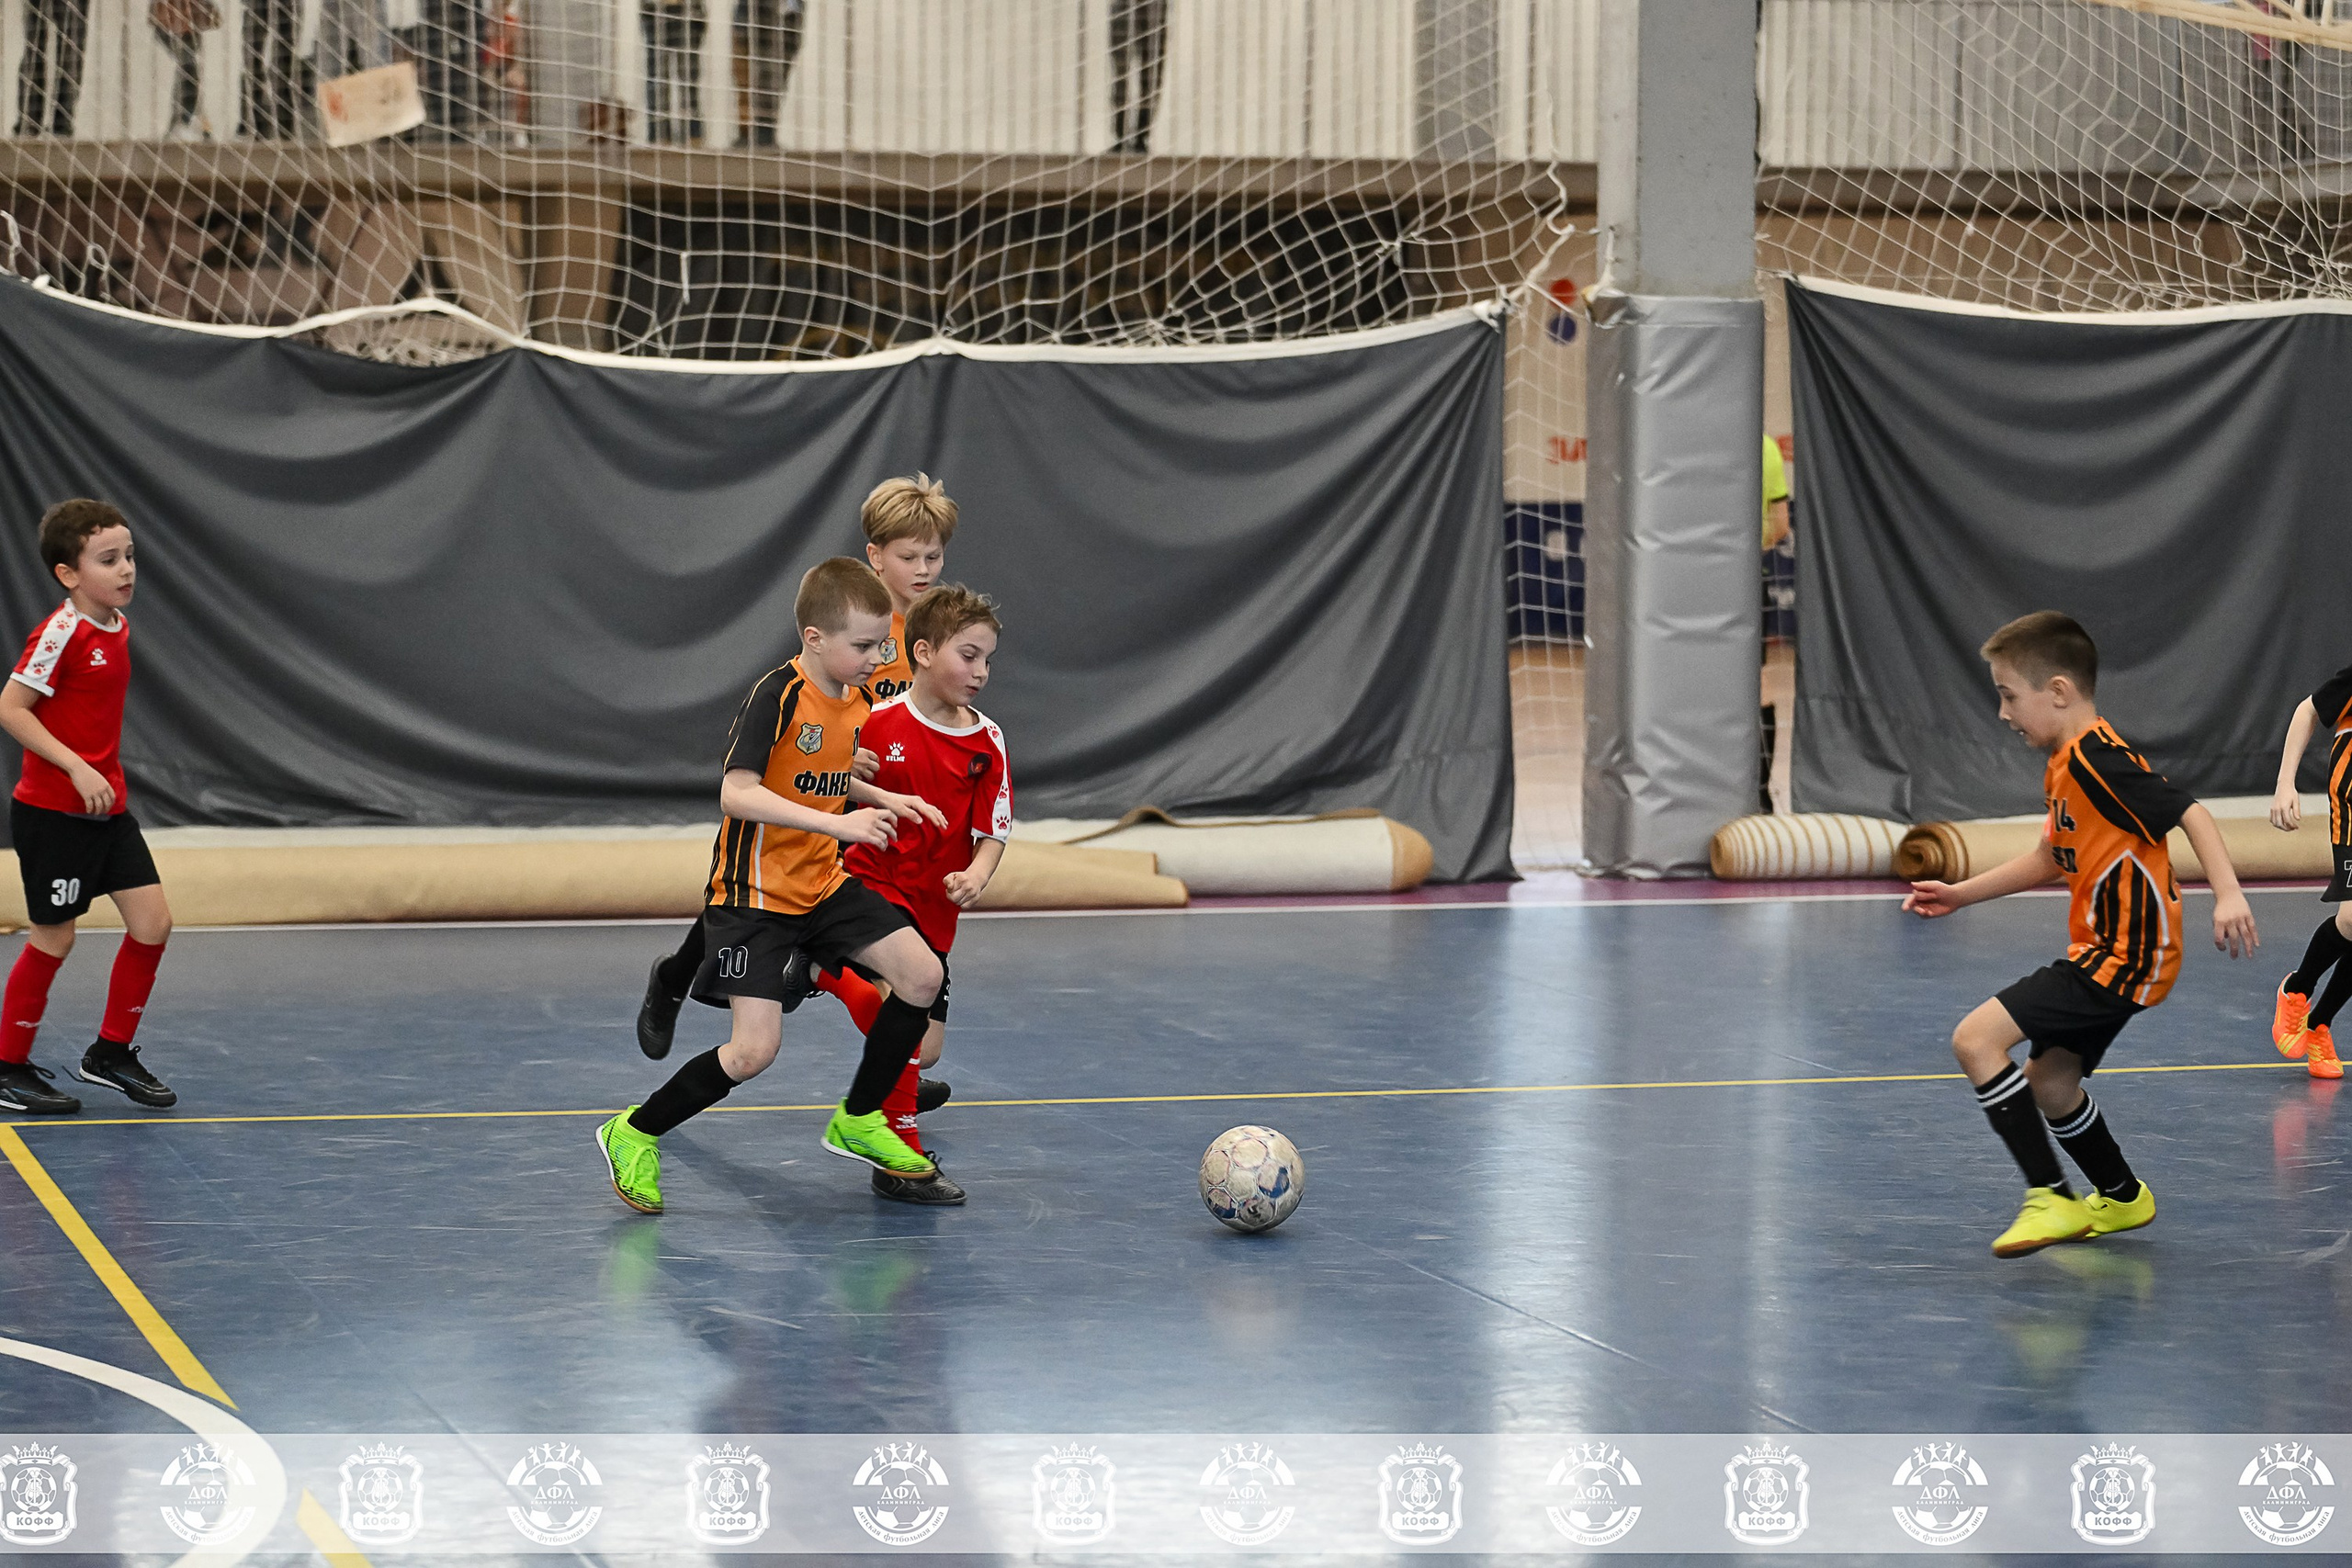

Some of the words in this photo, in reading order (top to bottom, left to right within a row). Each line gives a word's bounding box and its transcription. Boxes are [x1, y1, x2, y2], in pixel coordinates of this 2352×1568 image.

[875, 678, 914, 700] ФА
[51, 877, 81, 907] 30
[718, 945, 749, 979] 10
